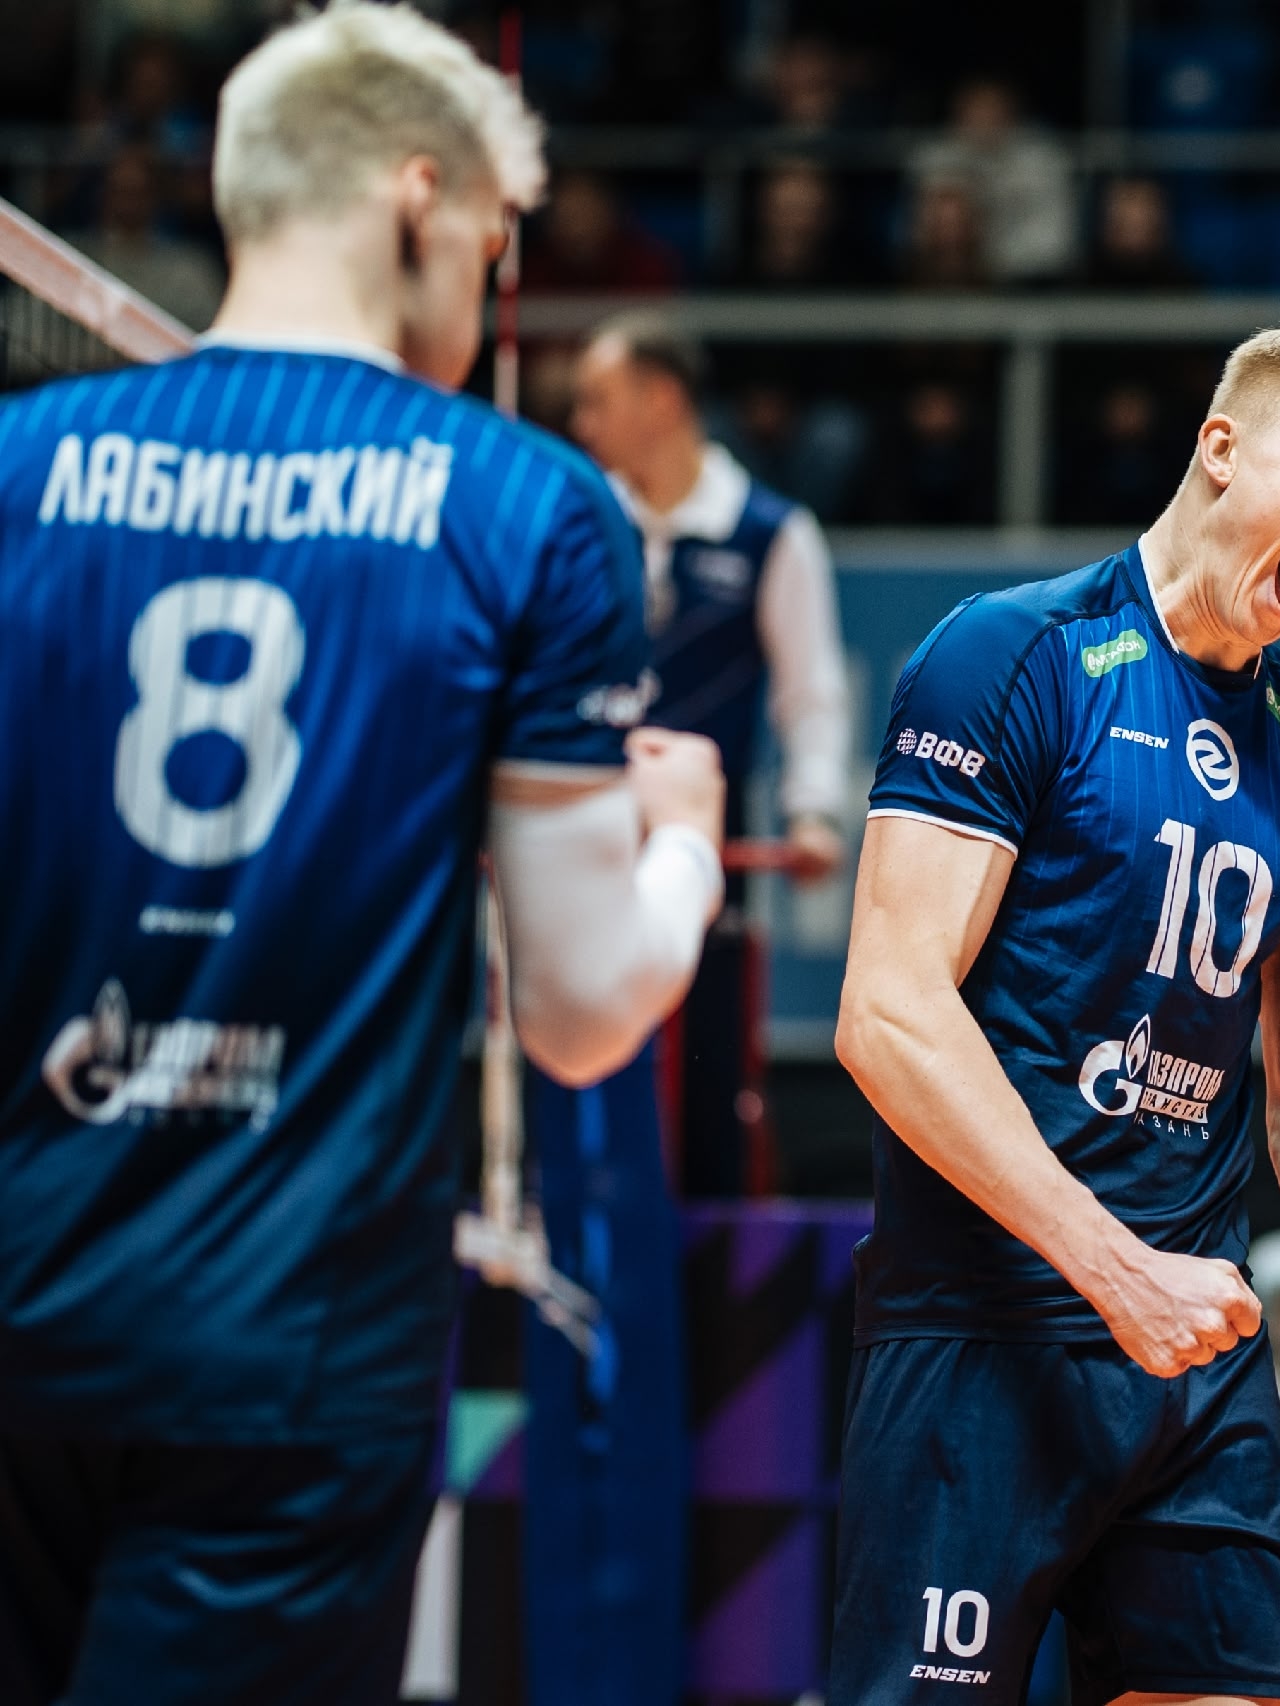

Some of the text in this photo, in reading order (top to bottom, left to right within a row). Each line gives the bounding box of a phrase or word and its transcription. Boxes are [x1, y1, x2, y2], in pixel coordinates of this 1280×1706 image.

[38, 432, 454, 551] ЛАБИНСКИЙ
[113, 575, 304, 868] 8
[1110, 725, 1170, 749] ENSEN
[914, 731, 987, 778] ВФВ
[1146, 817, 1274, 998] 10
[1146, 1049, 1226, 1102] ГАЗПРОМ
[922, 1586, 991, 1658] 10
[908, 1664, 991, 1685] ENSEN
